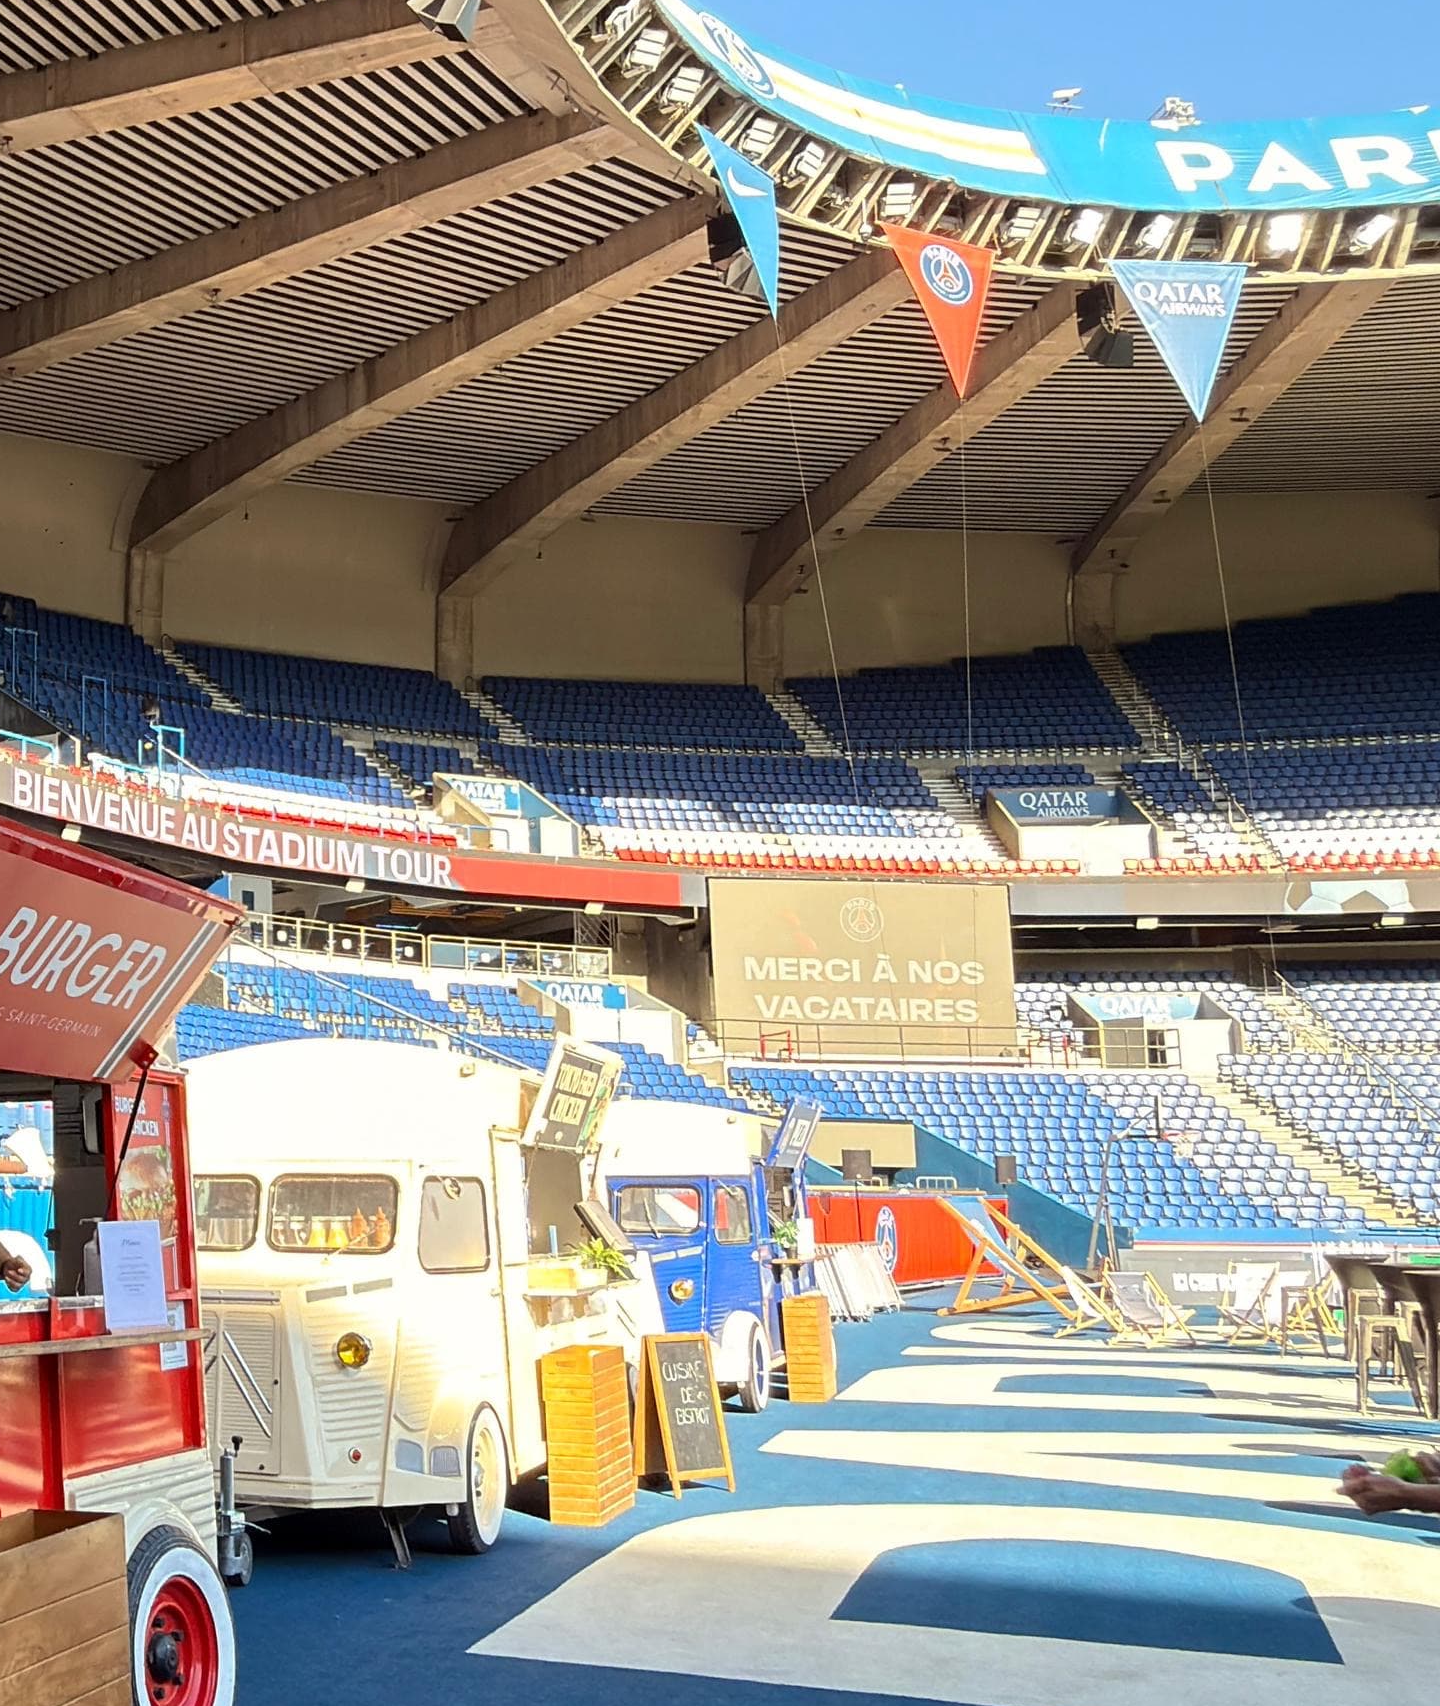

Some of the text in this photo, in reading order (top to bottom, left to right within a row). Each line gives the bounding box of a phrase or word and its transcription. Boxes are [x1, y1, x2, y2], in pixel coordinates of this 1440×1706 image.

[1133, 281, 1225, 308] QATAR
[1160, 302, 1226, 317] AIRWAYS
[1019, 791, 1089, 811] QATAR
[1036, 806, 1090, 818] AIRWAYS
[13, 767, 453, 887] BIENVENUE AU STADIUM TOUR
[744, 953, 985, 985] MERCI À NOS
[754, 995, 979, 1023] VACATAIRES
[7, 1008, 103, 1038] SAINT-GERMAIN
